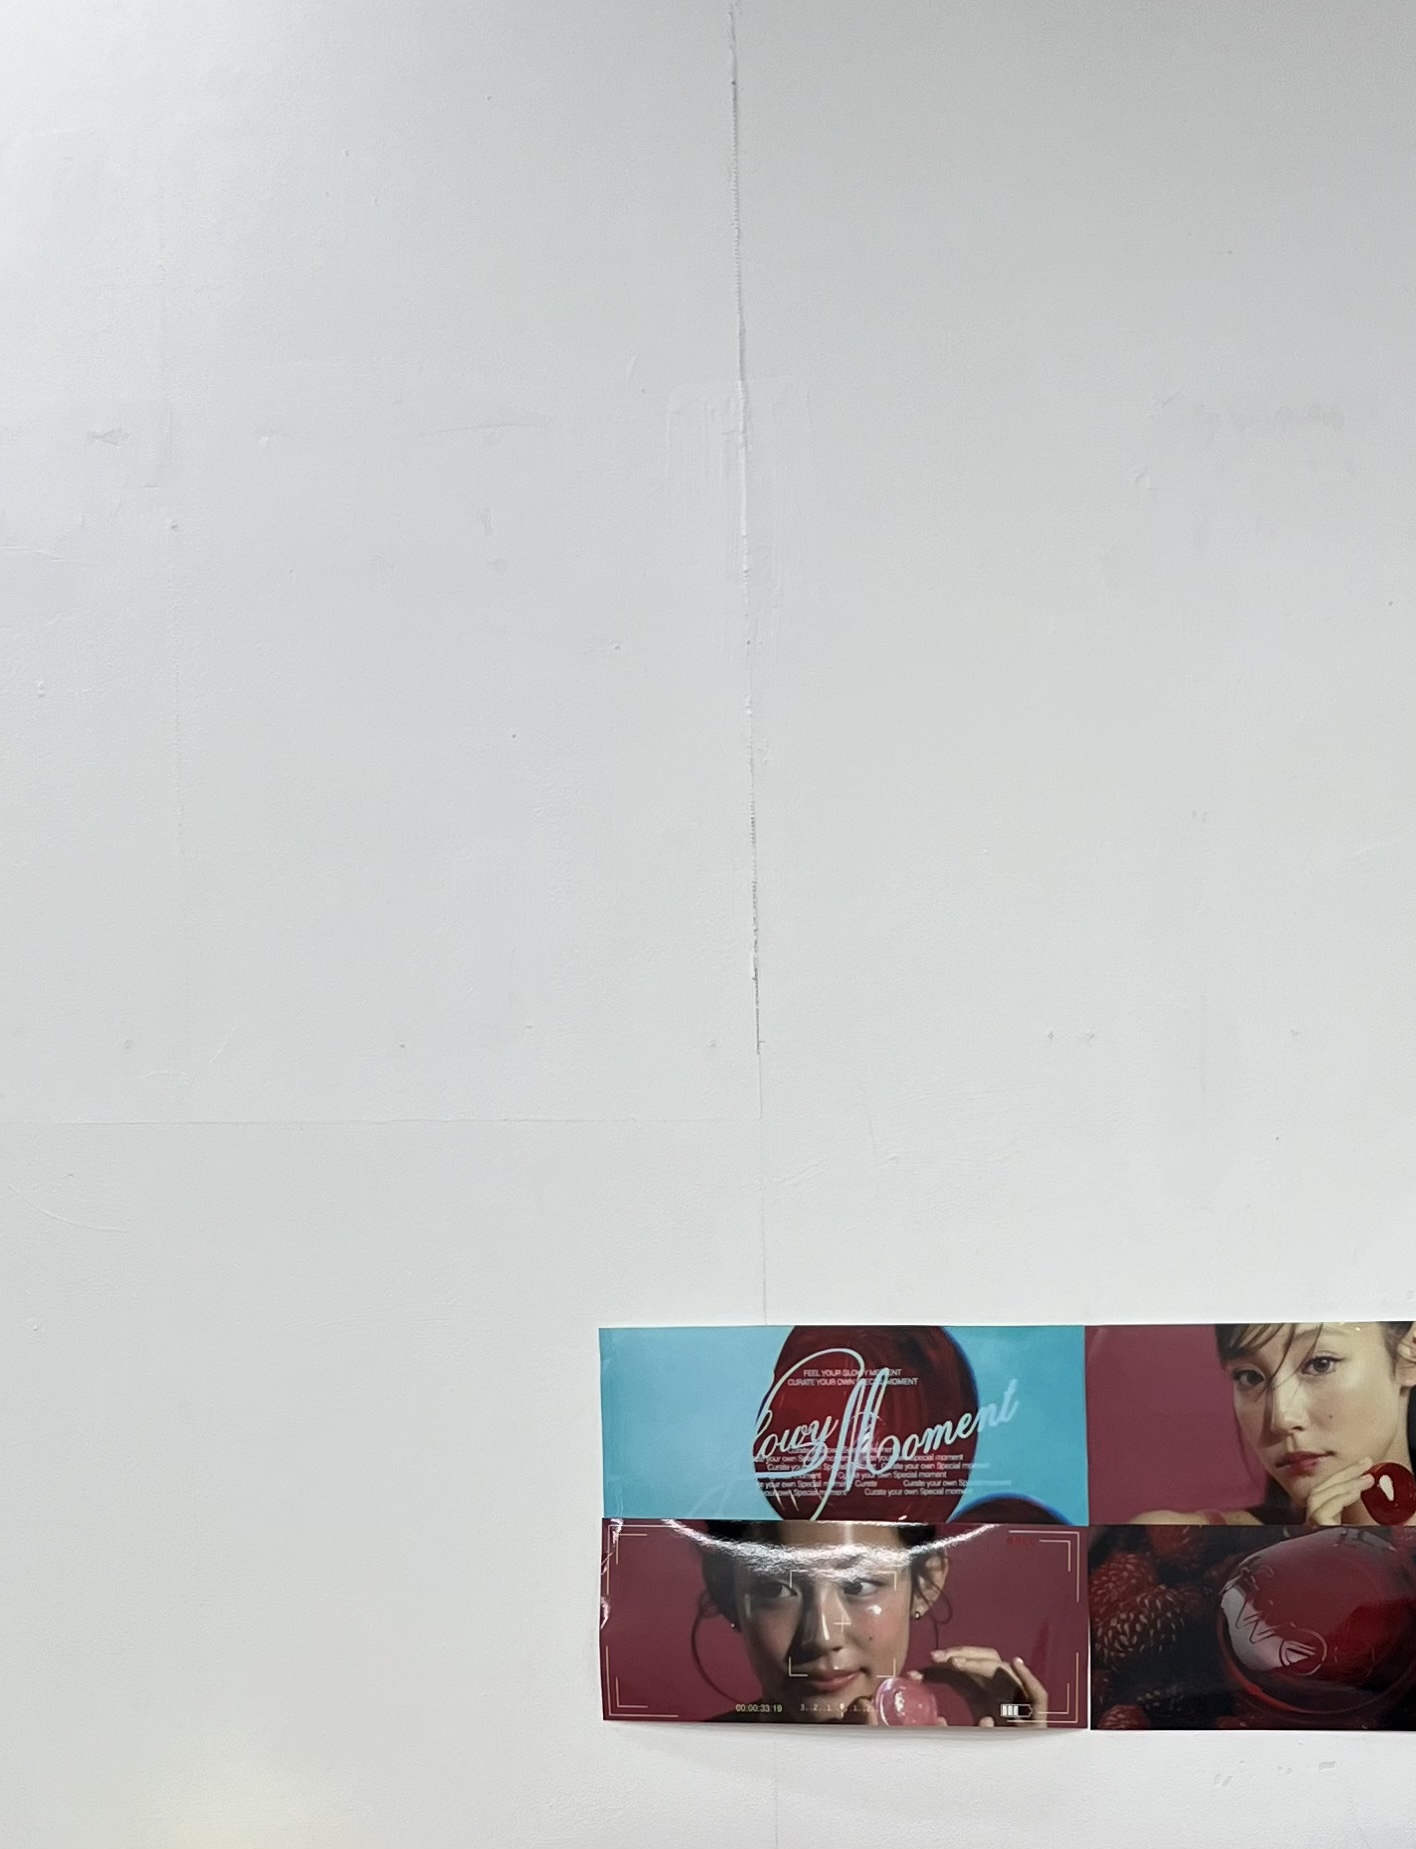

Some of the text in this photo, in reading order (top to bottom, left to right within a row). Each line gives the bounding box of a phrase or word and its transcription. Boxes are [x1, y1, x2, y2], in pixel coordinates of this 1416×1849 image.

[803, 1369, 820, 1377] FEEL
[821, 1369, 841, 1377] YOUR
[842, 1369, 868, 1377] GLOY
[787, 1378, 815, 1386] CURATE
[816, 1378, 836, 1386] YOUR
